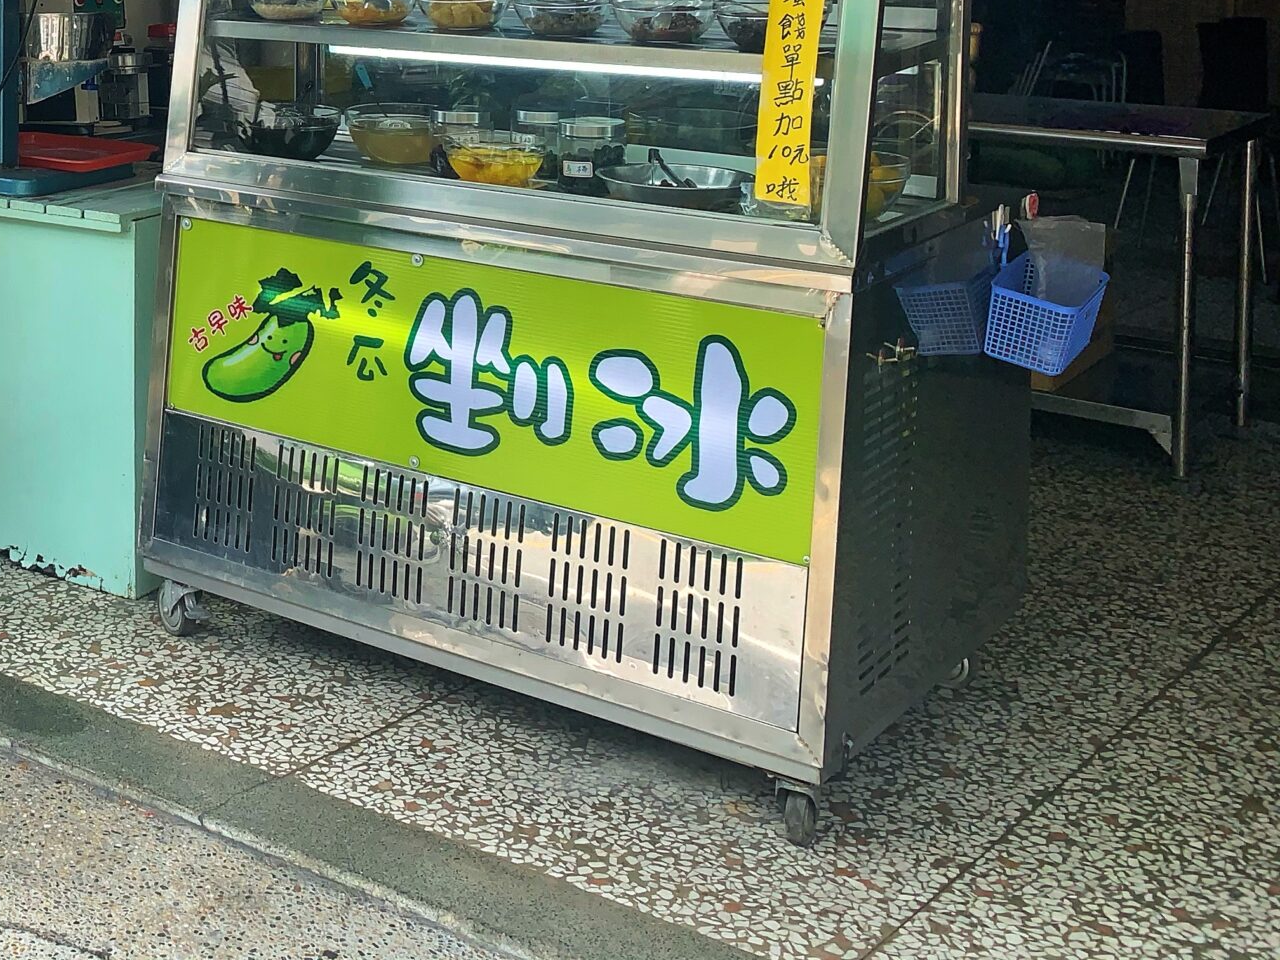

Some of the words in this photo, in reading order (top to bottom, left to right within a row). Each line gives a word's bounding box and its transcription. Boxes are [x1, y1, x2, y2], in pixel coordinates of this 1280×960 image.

[188, 294, 255, 353] 古早味
[346, 260, 397, 382] 冬瓜
[403, 287, 798, 512] 剉冰
